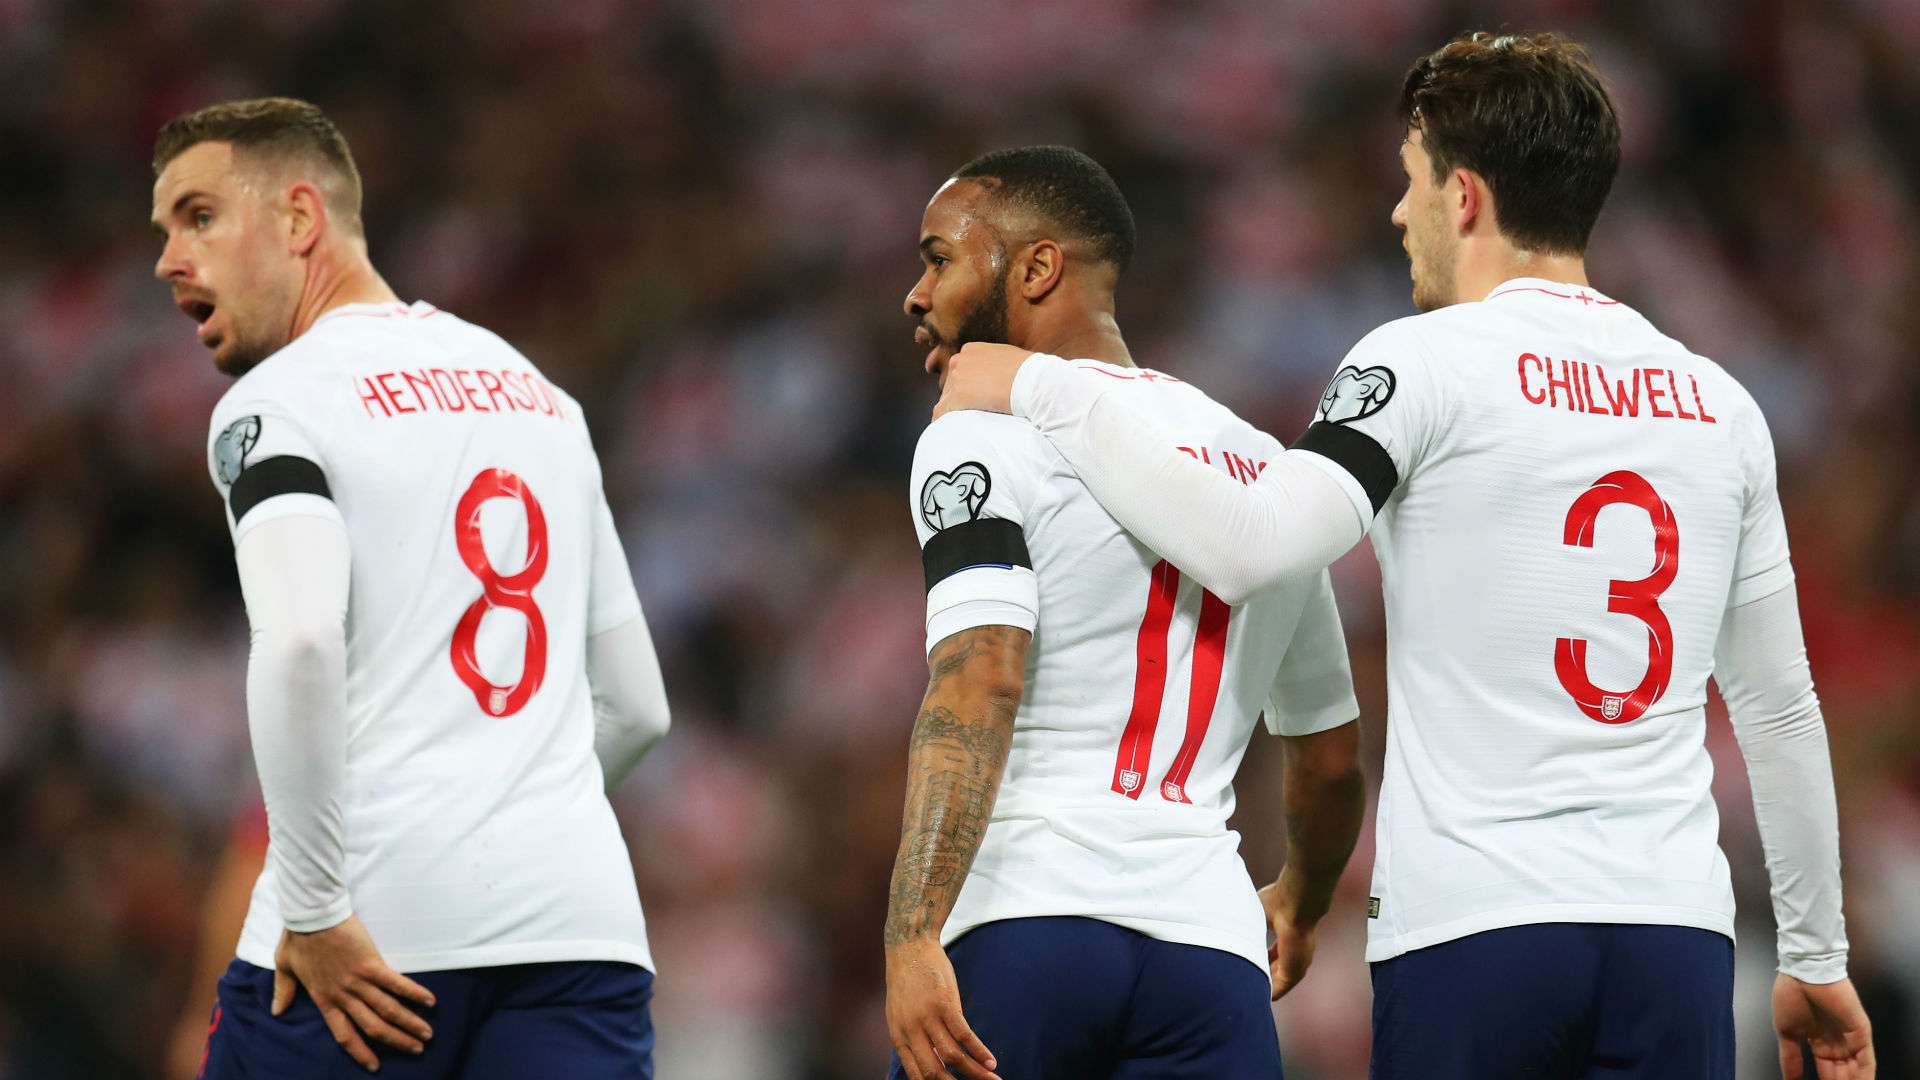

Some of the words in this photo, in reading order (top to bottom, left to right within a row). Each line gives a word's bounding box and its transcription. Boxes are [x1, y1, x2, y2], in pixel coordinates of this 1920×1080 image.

[1518, 352, 1717, 424] CHILWELL
[450, 467, 549, 720] 8
[1111, 558, 1231, 805] 11
[1554, 469, 1680, 725] 3
